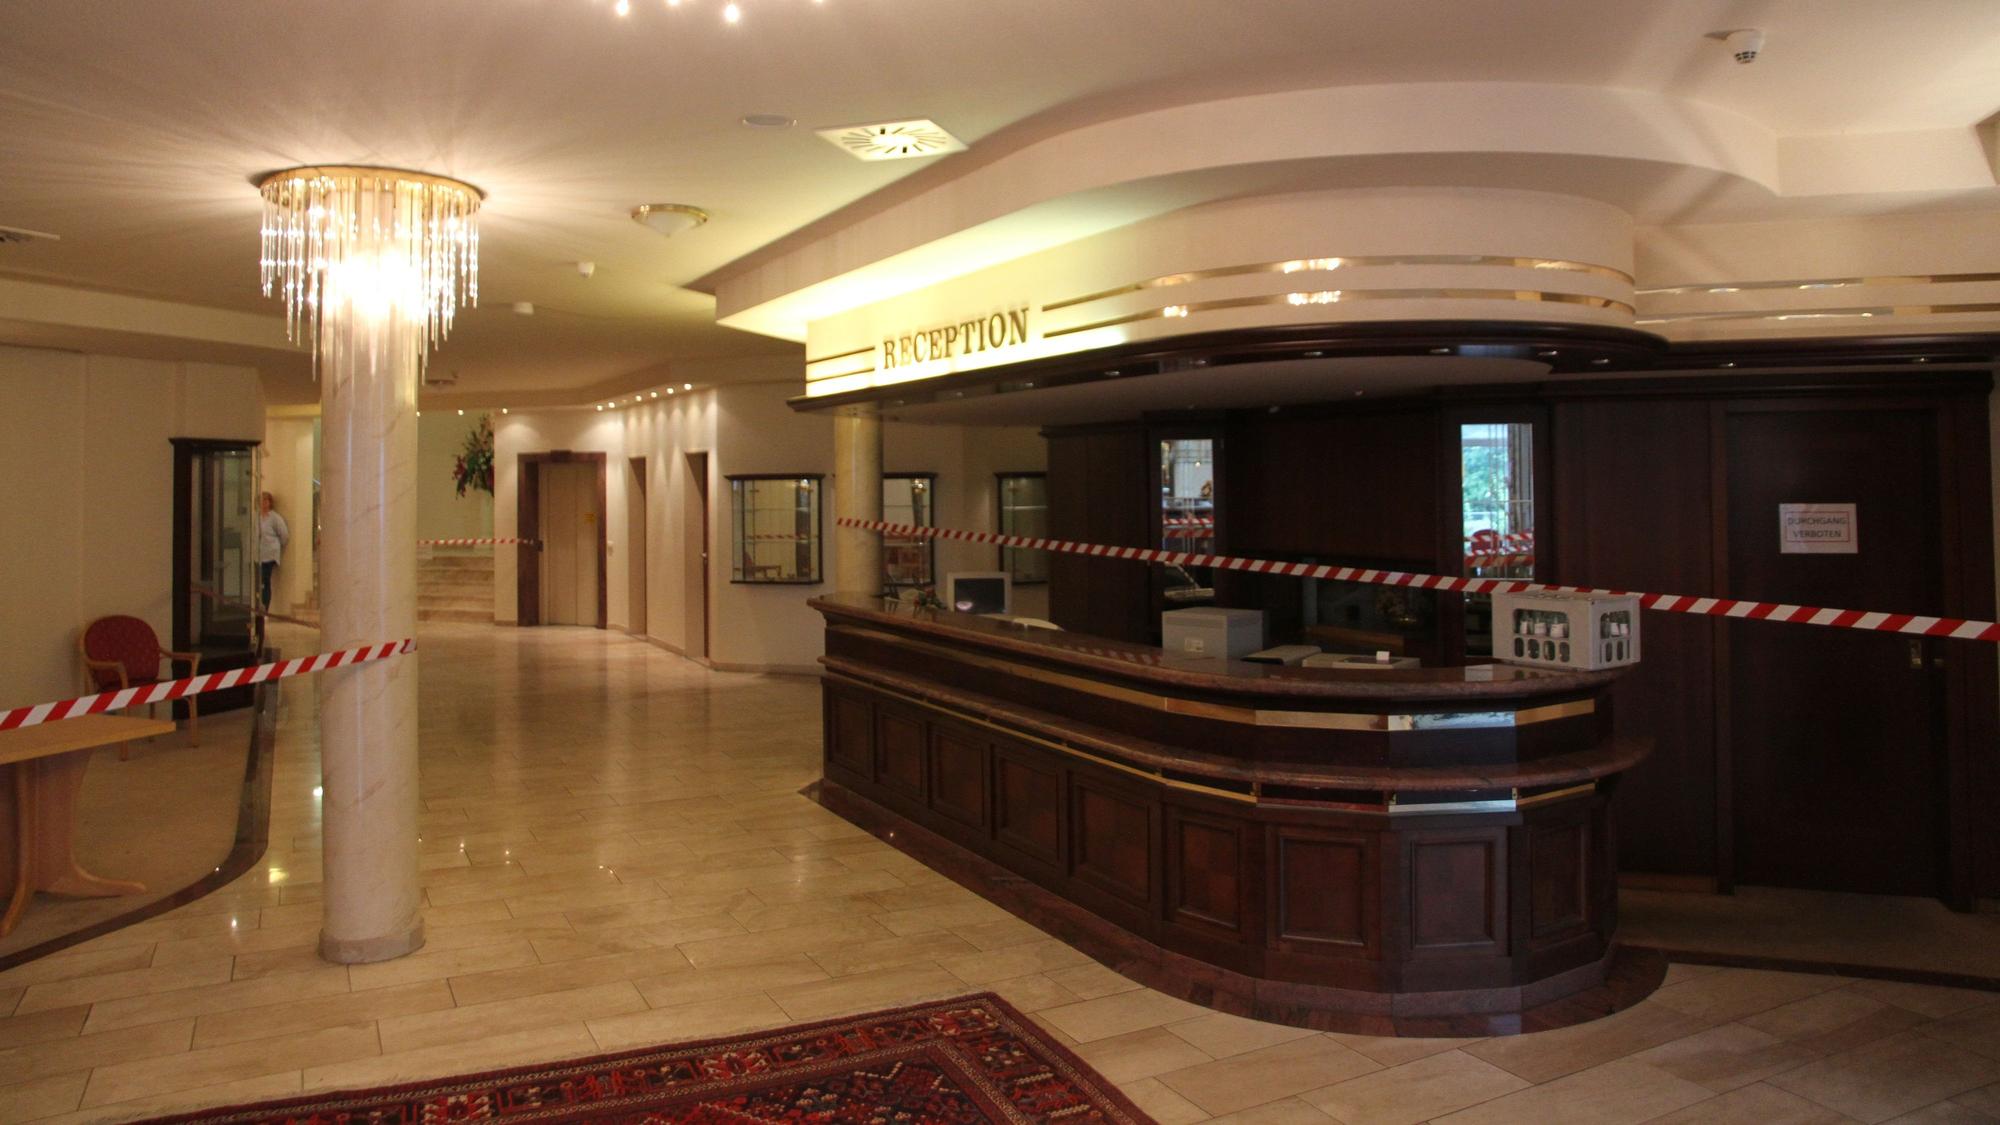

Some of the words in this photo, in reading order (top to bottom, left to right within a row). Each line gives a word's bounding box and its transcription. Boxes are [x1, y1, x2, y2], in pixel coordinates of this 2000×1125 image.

[883, 308, 1029, 370] RECEPTION
[1787, 517, 1847, 525] DURCHGANG
[1792, 529, 1841, 538] VERBOTEN
